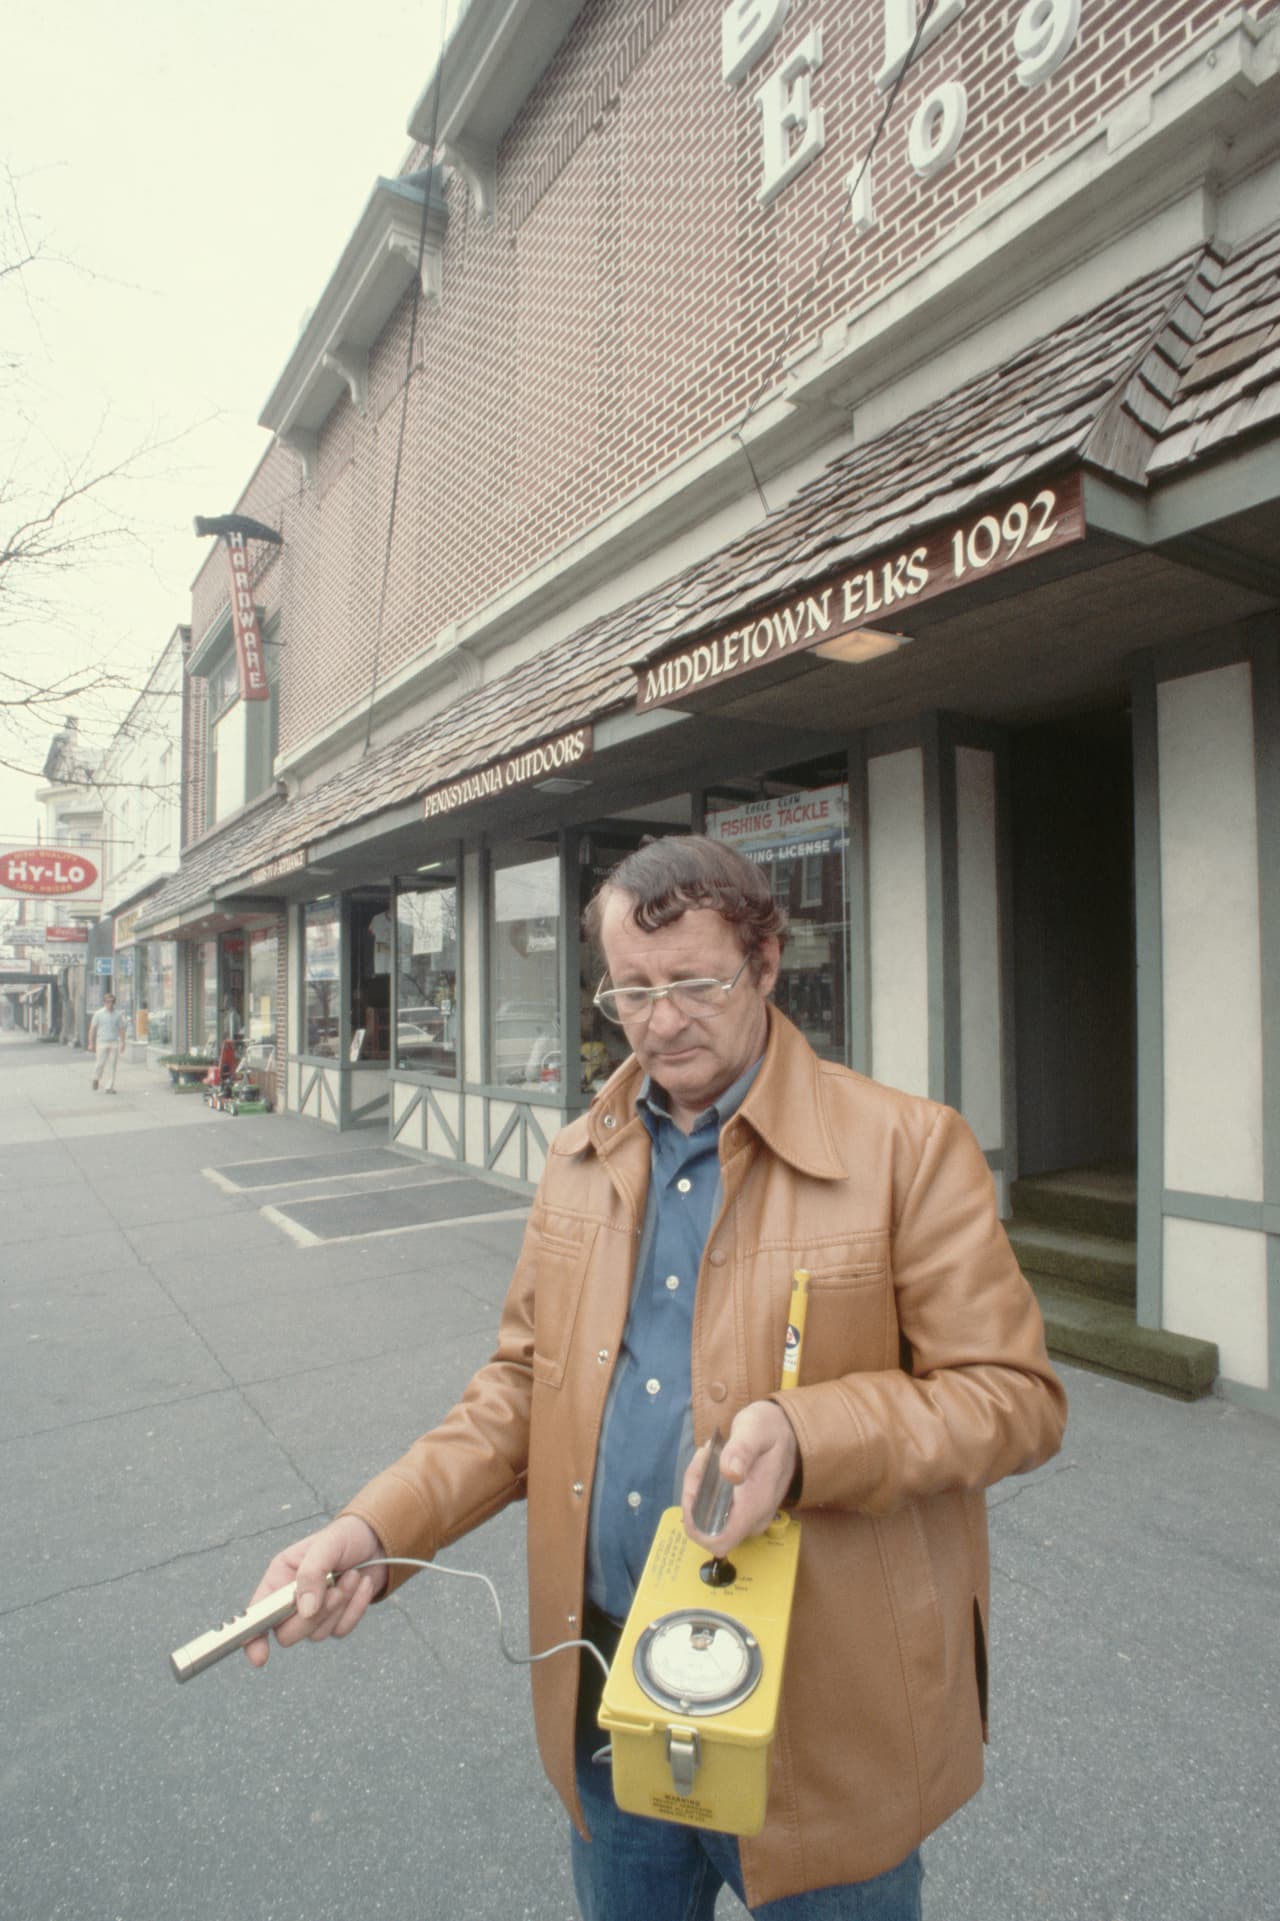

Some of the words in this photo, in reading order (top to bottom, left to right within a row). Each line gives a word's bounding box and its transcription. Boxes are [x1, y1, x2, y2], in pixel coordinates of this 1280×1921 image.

[228, 531, 266, 690] HARDWARE
[644, 587, 833, 704] MIDDLETOWN
[842, 546, 929, 623] ELKS
[952, 489, 1059, 578] 1092
[424, 765, 504, 819] PENNSYLVANIA
[505, 730, 585, 786] OUTDOORS
[720, 814, 773, 838] FISHING
[777, 800, 829, 826] TACKLE
[745, 848, 774, 864] HING
[778, 839, 831, 860] LICENSE
